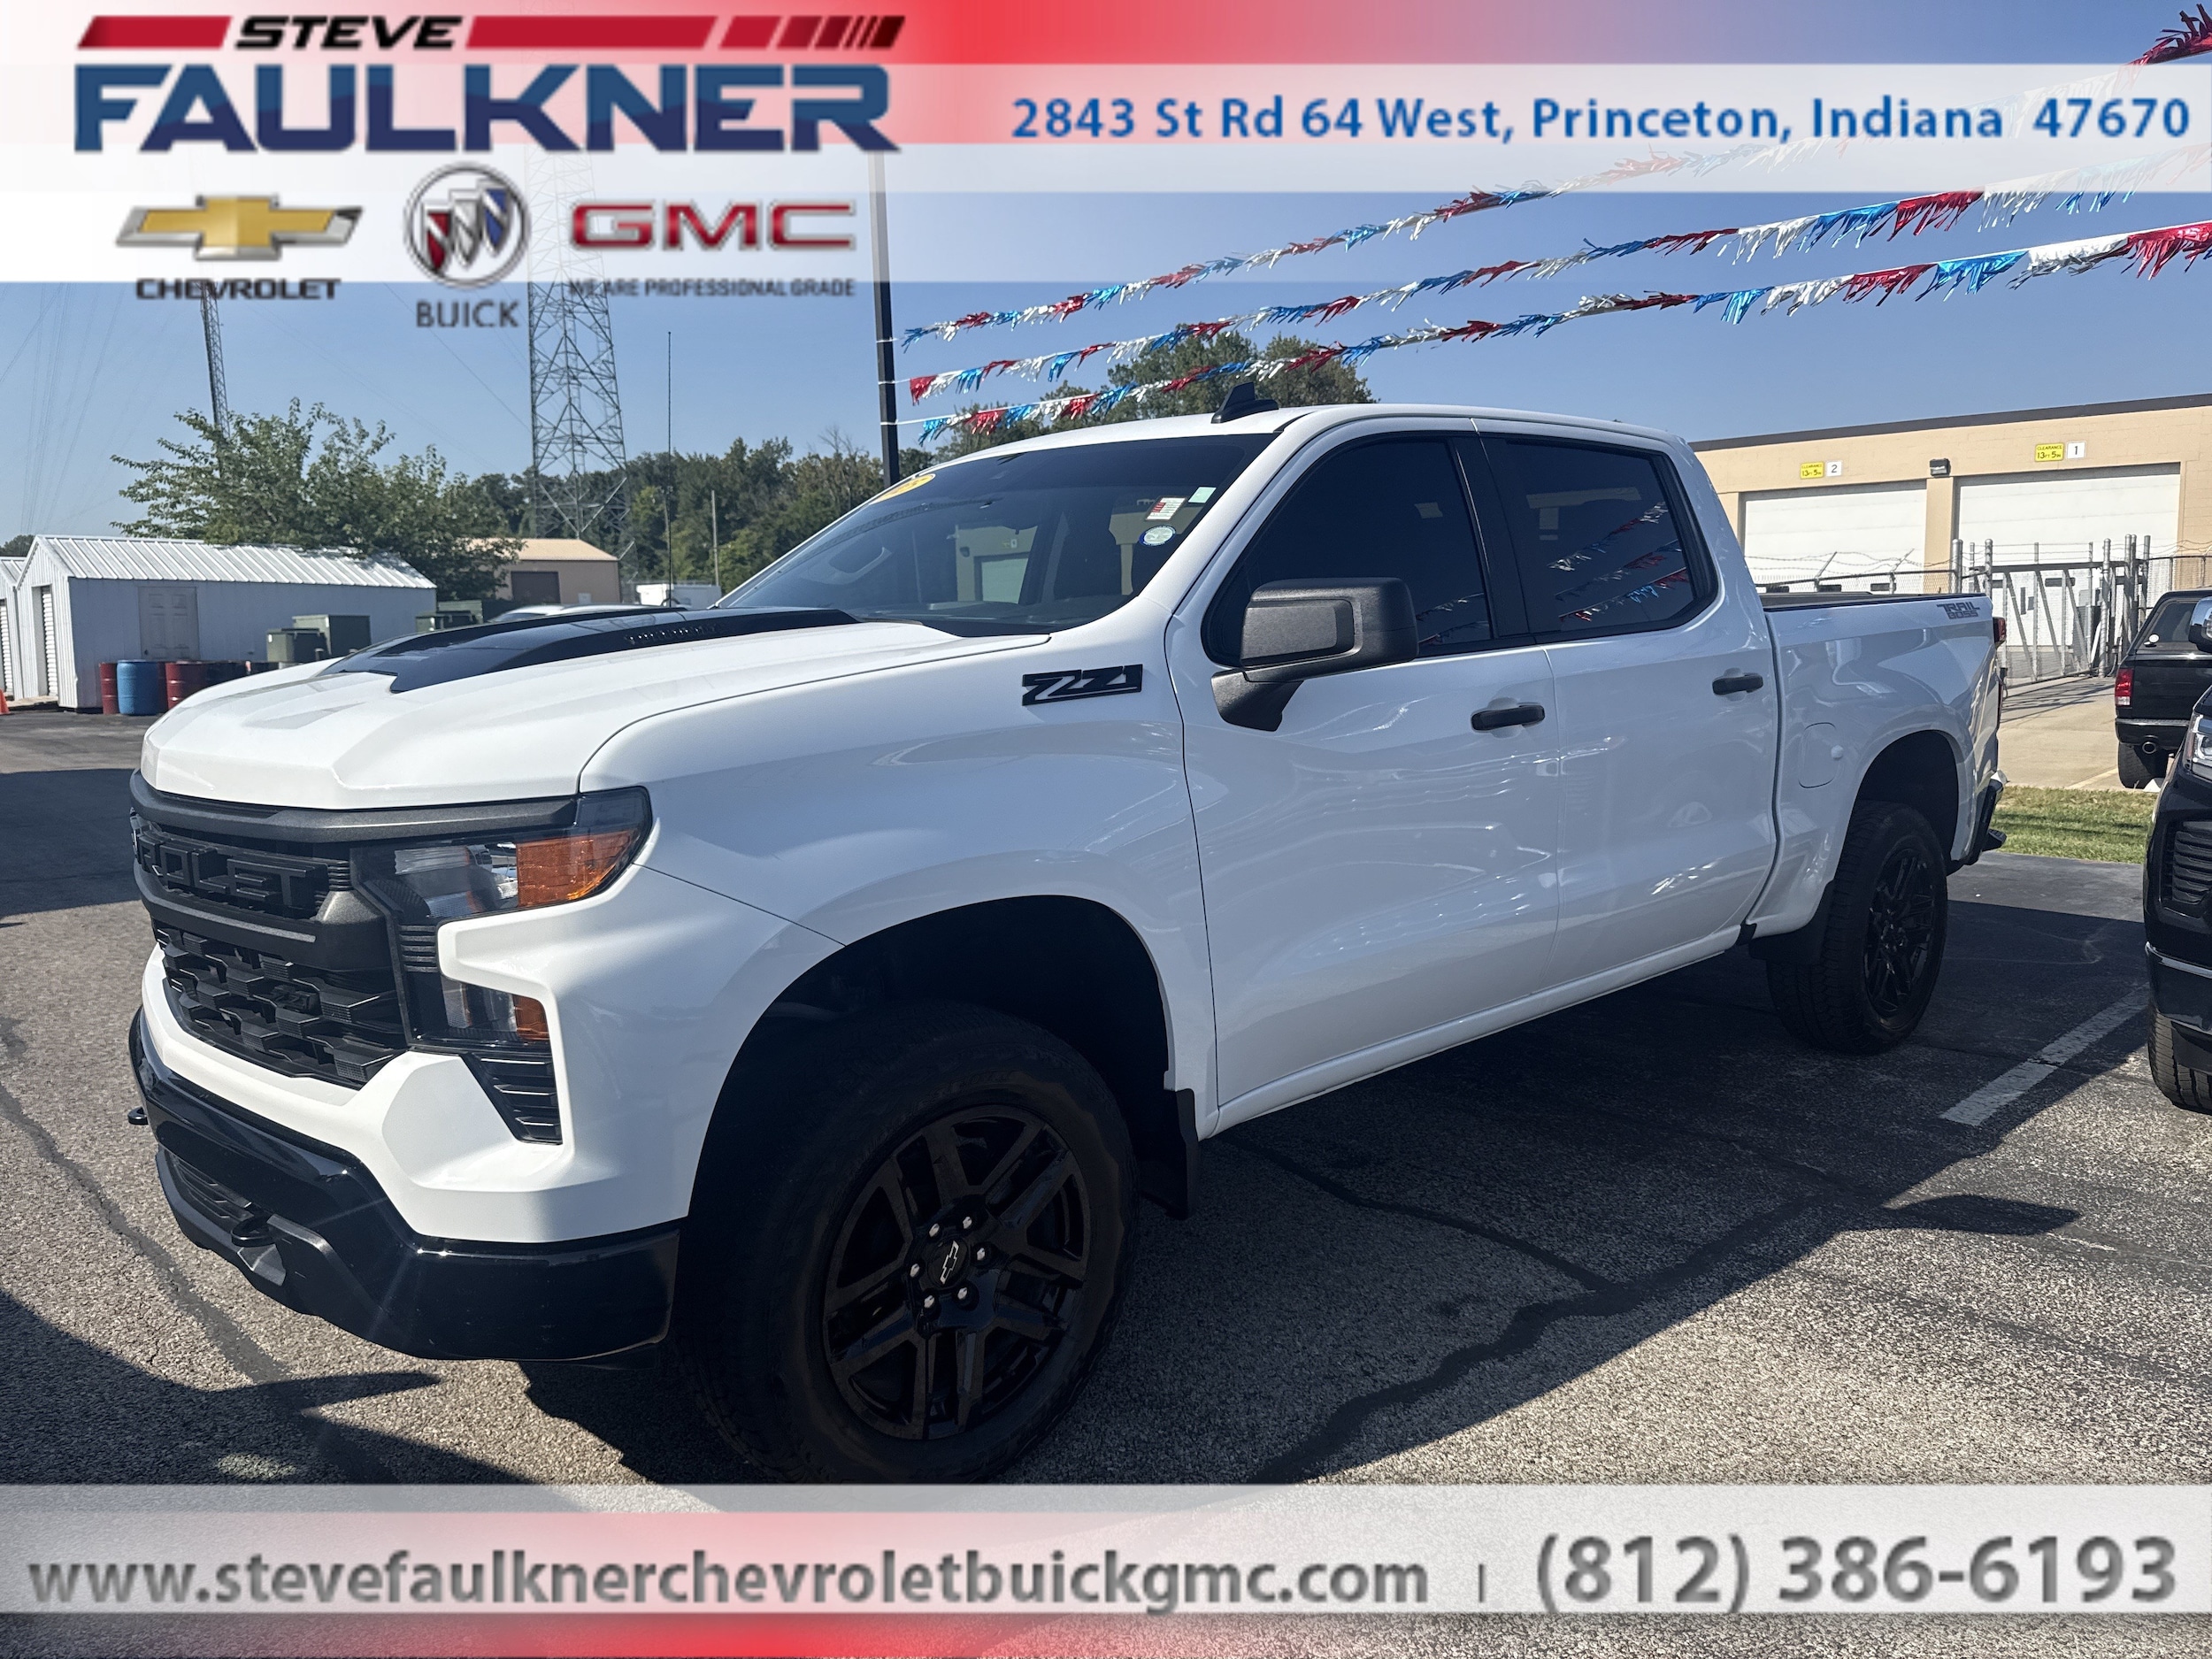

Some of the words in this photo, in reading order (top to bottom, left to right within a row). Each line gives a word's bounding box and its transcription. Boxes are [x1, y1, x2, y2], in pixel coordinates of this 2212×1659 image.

[1831, 464, 1838, 473] 2
[1937, 602, 1981, 612] TRAIL
[1947, 610, 1979, 620] BOSS
